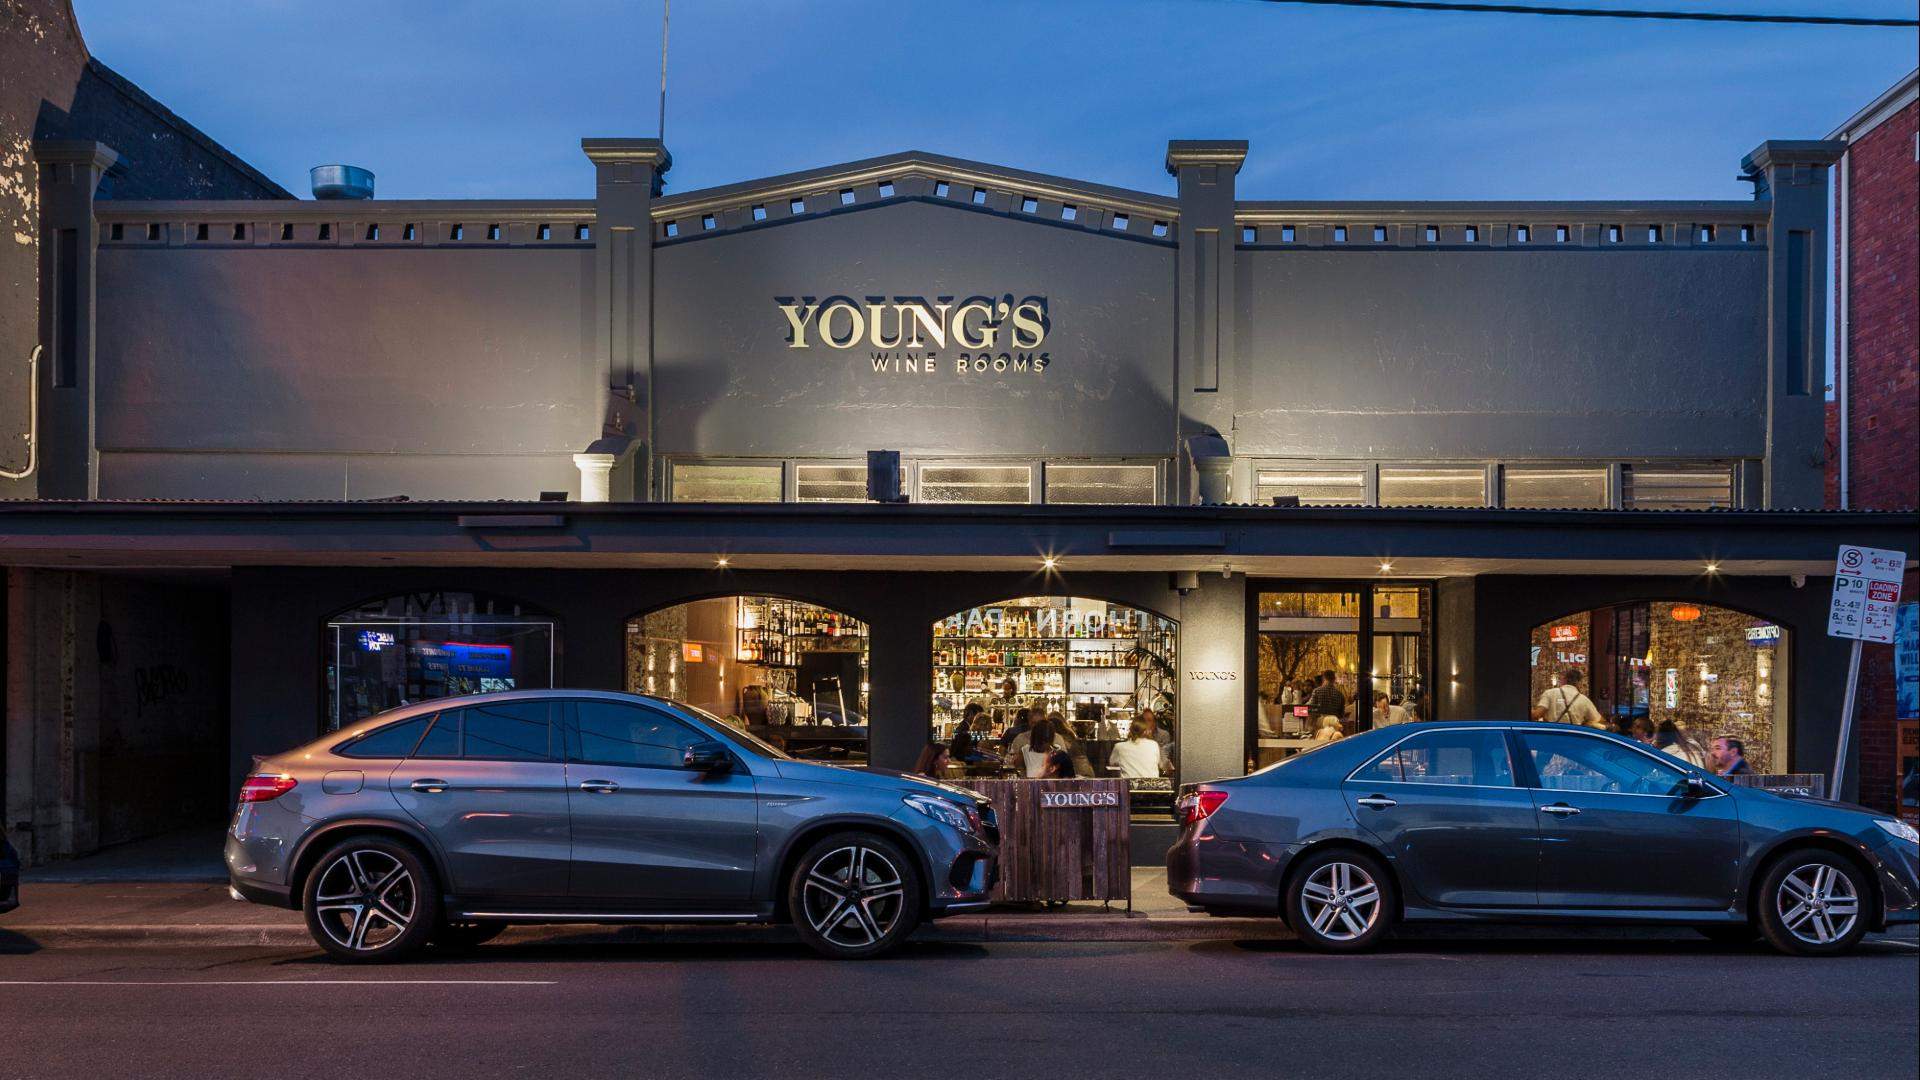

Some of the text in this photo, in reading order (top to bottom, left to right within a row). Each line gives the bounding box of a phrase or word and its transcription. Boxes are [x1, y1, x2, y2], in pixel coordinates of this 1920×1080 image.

[778, 302, 1046, 350] YOUNG'S
[871, 358, 1045, 373] WINE ROOMS
[1836, 578, 1849, 591] P
[1869, 582, 1899, 593] LOADING
[1872, 591, 1893, 601] ZONE
[1189, 671, 1237, 681] YOUNG'S
[1044, 791, 1117, 807] YOUNG'S
